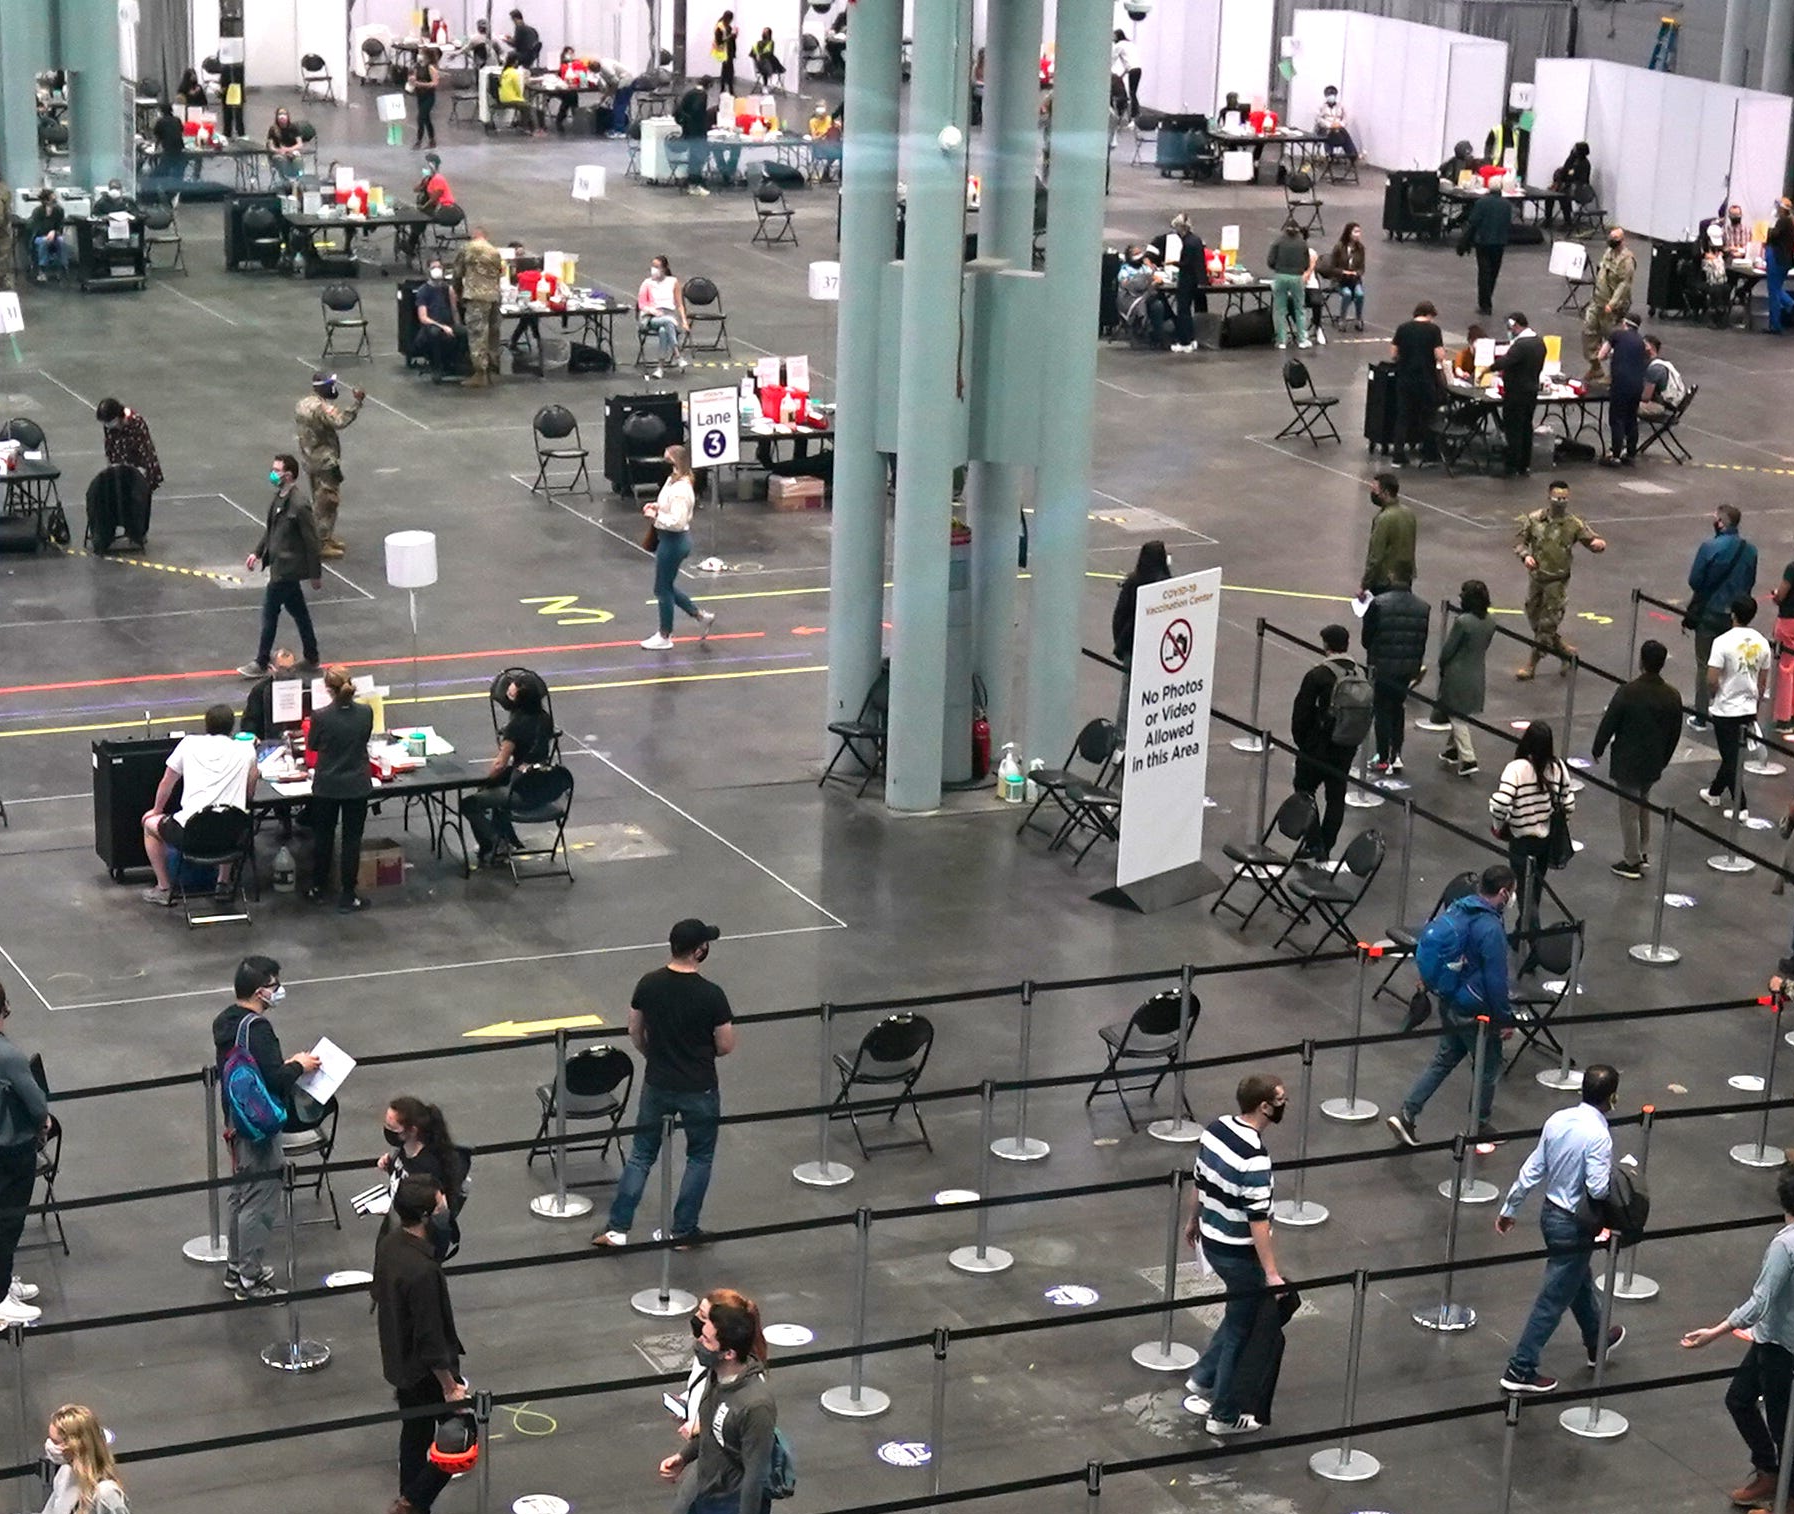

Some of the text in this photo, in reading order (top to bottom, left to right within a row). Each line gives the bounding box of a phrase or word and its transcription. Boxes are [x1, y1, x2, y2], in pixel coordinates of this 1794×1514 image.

[822, 275, 839, 291] 37
[697, 411, 731, 427] Lane
[708, 433, 722, 456] 3
[1162, 584, 1197, 599] COVID-19
[1146, 593, 1214, 615] Vaccination Center
[1141, 679, 1203, 707] No Photos
[1145, 702, 1197, 727] or Video
[1145, 720, 1194, 748] Allowed
[1132, 742, 1199, 773] in this Area
